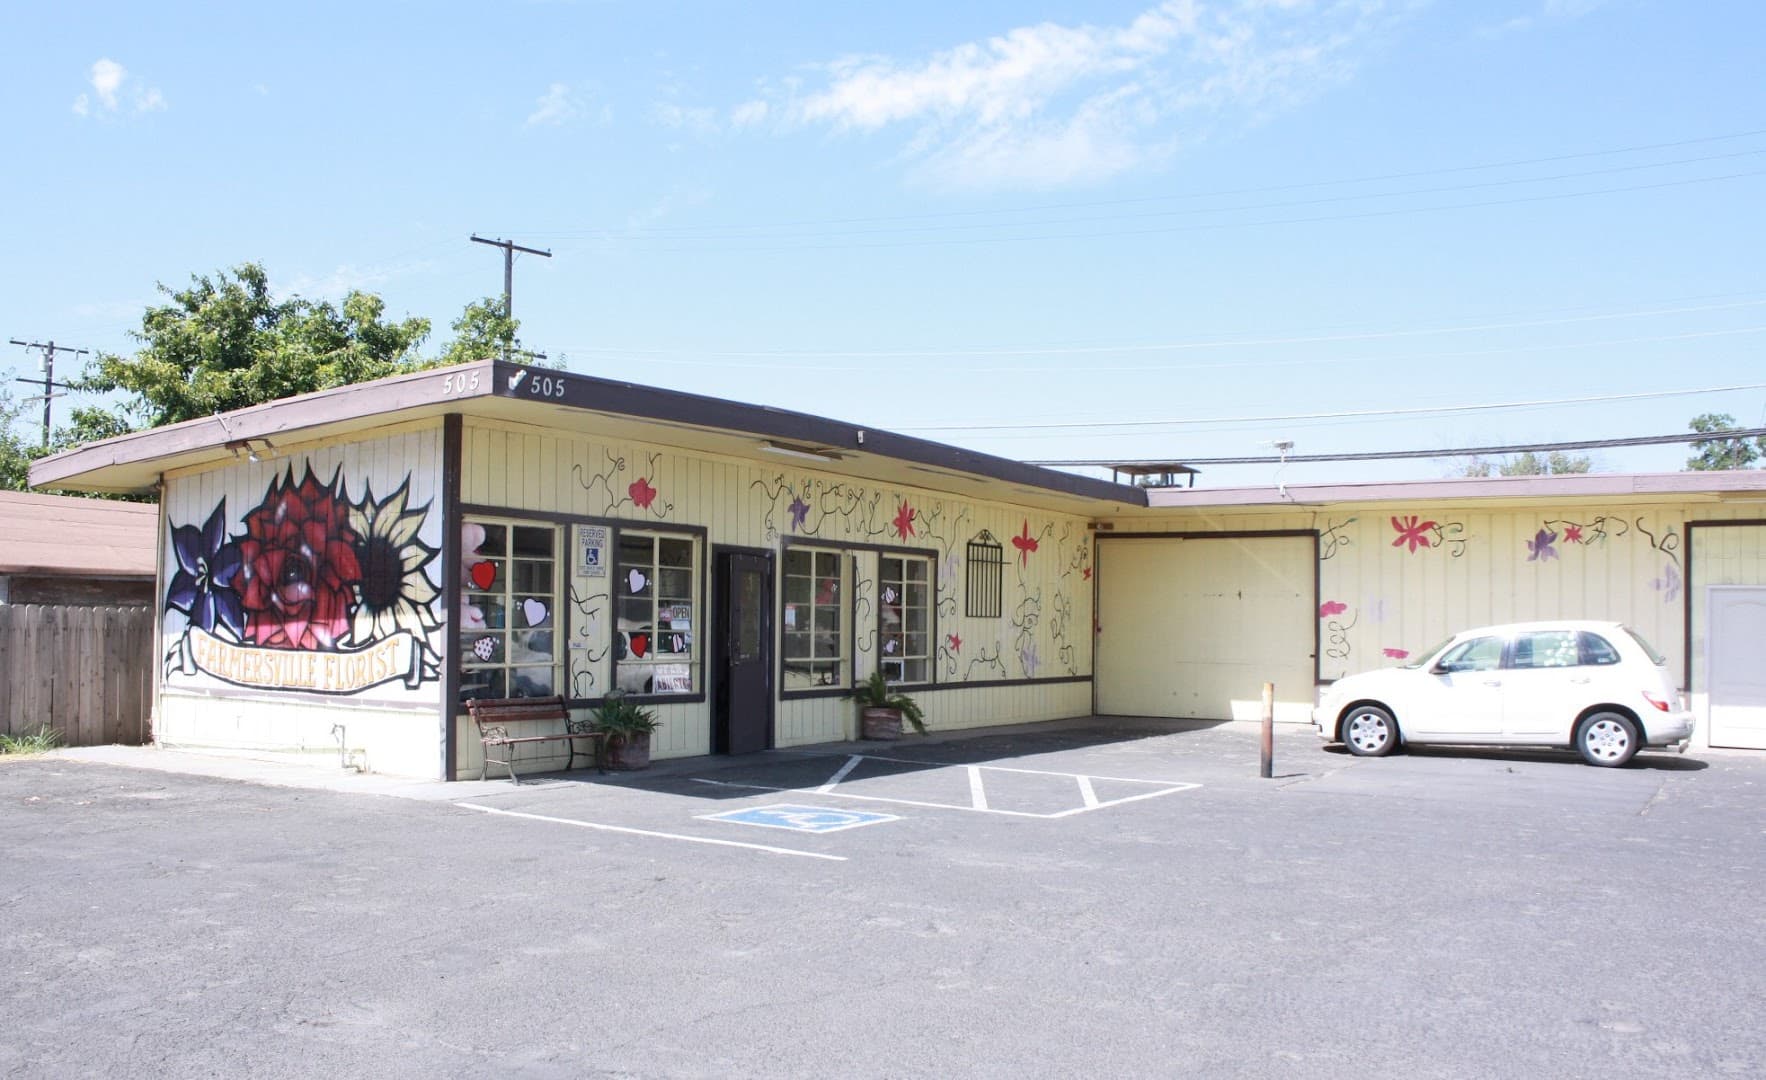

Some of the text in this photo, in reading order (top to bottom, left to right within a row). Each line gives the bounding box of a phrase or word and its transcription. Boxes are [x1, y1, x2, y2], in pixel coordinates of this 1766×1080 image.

[443, 371, 480, 394] 505
[531, 376, 565, 397] 505
[580, 527, 605, 538] RESERVED
[581, 538, 604, 548] PARKING
[673, 607, 690, 618] OPEN
[199, 636, 399, 689] FARMERSVILLE FLORIST
